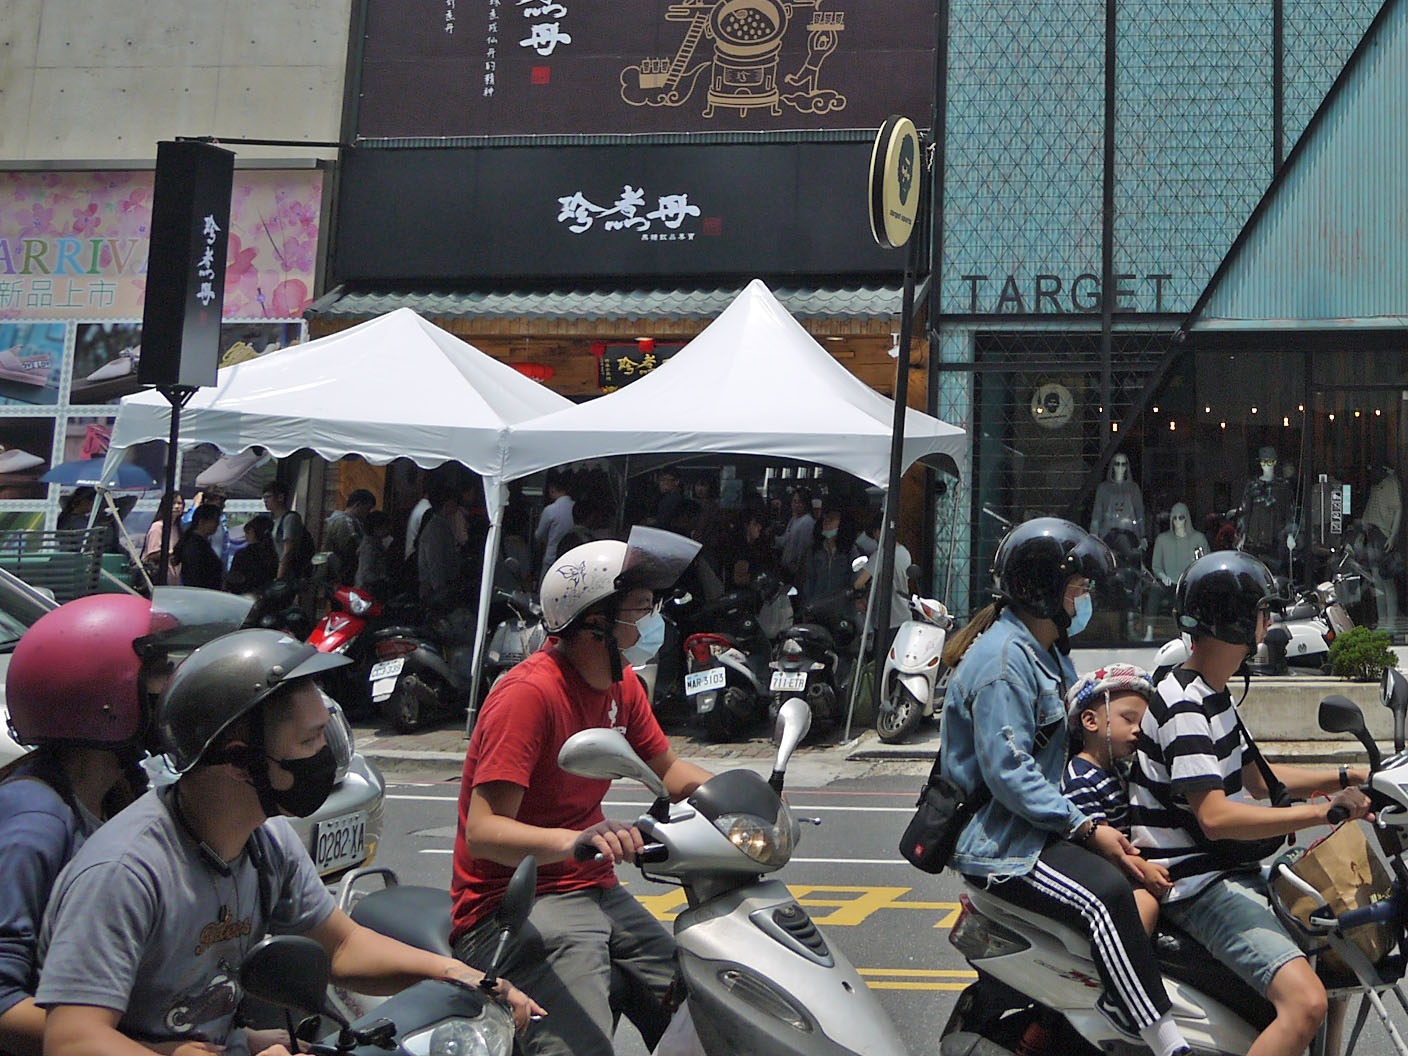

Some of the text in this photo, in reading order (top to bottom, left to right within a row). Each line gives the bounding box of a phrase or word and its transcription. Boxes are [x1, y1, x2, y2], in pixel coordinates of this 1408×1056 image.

[557, 184, 701, 234] 珍煮丹
[0, 237, 149, 276] ARRIV
[0, 279, 117, 309] 新品上市
[961, 273, 1172, 314] TARGET
